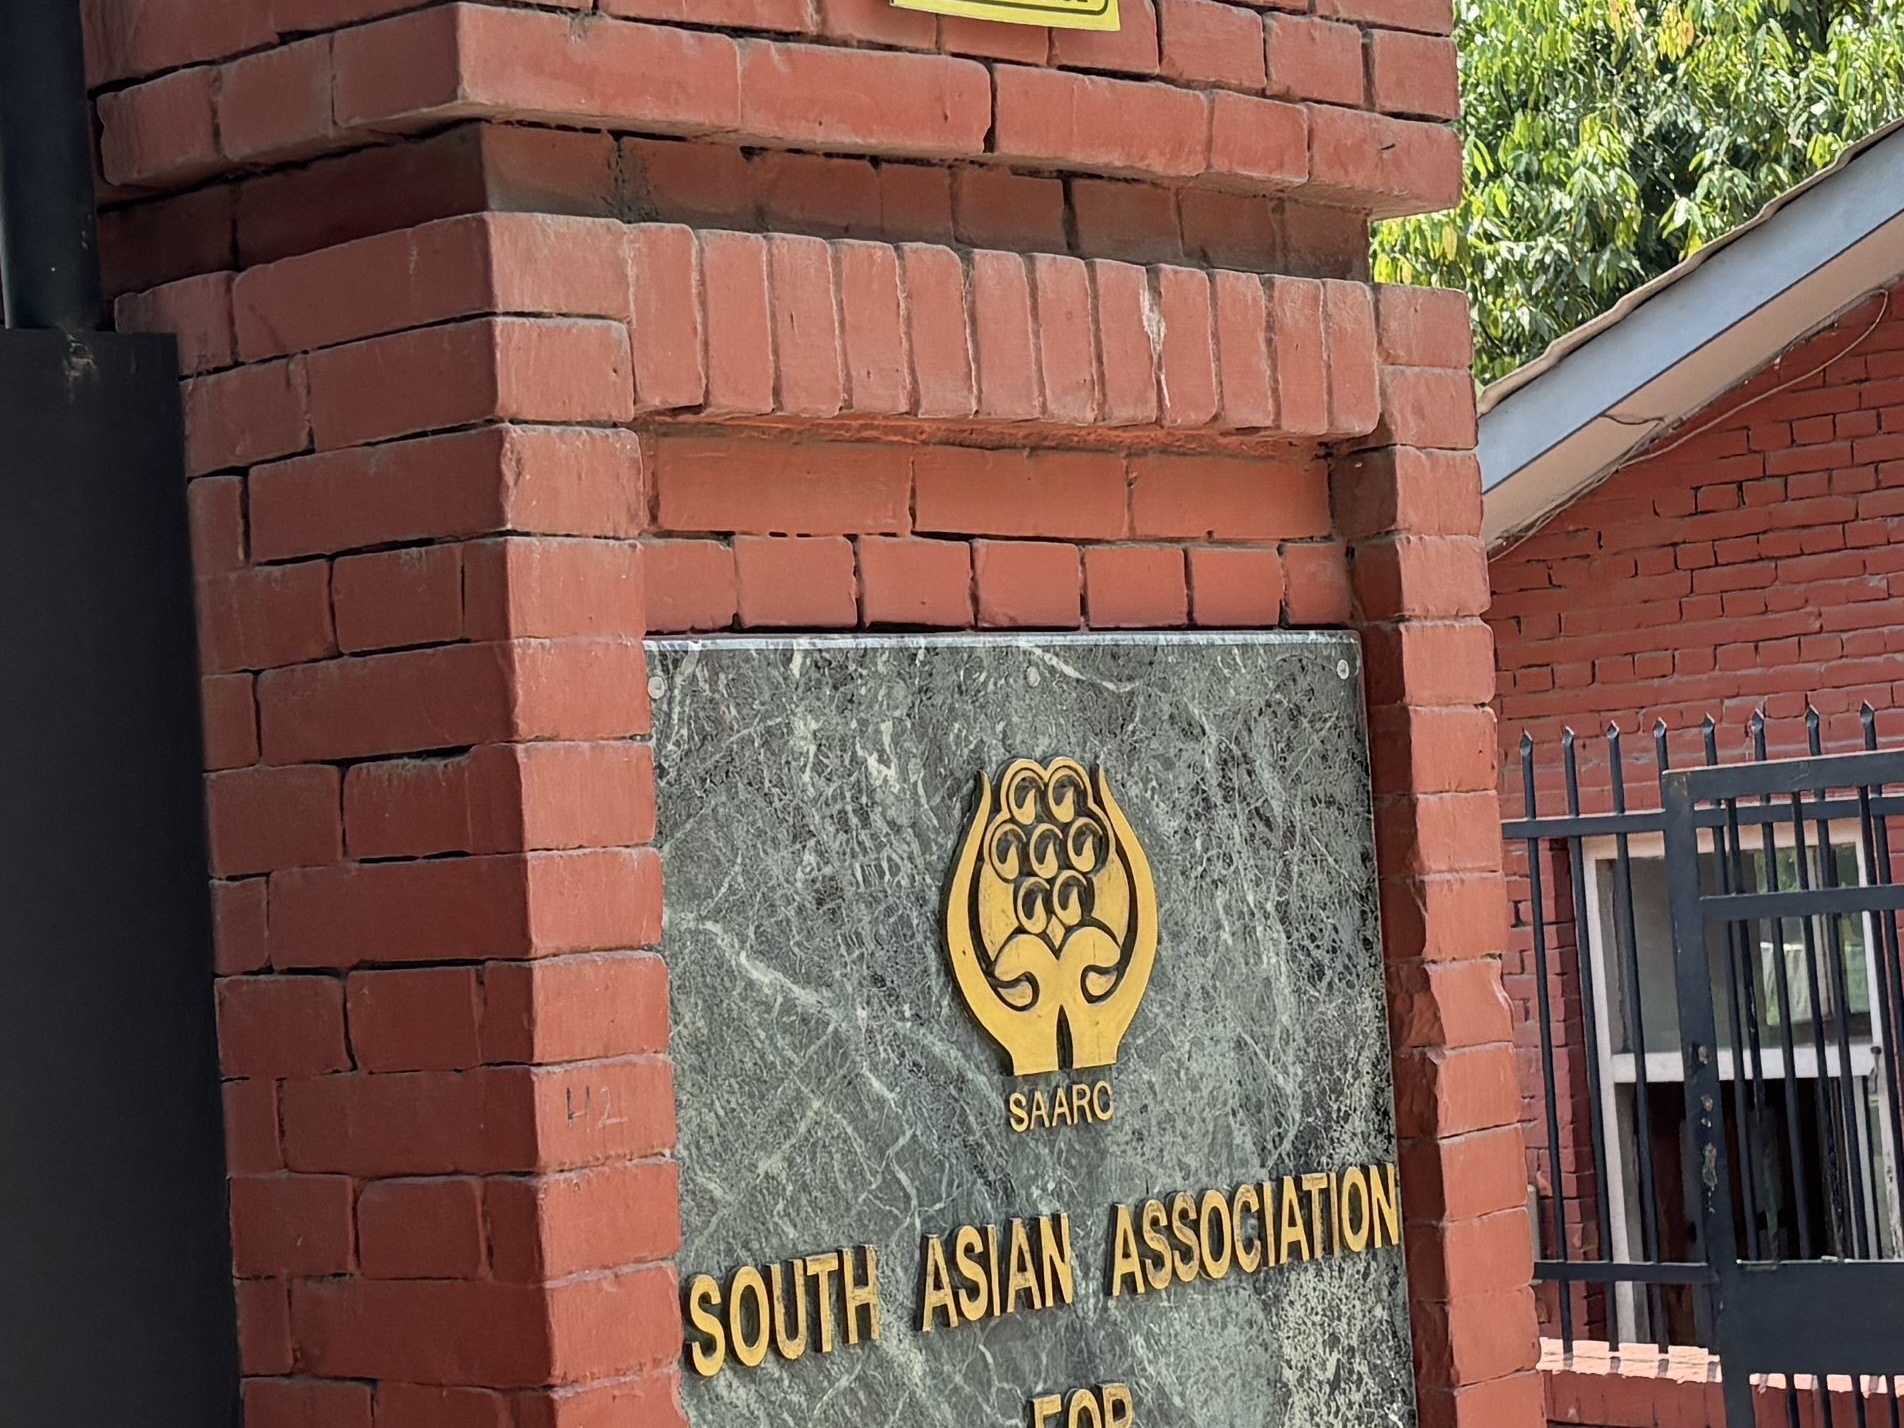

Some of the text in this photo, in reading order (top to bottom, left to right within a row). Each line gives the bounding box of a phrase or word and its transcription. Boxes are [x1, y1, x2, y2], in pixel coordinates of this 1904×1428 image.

[1007, 1079, 1115, 1134] SAARC
[686, 1164, 1401, 1378] SOUTH ASIAN ASSOCIATION
